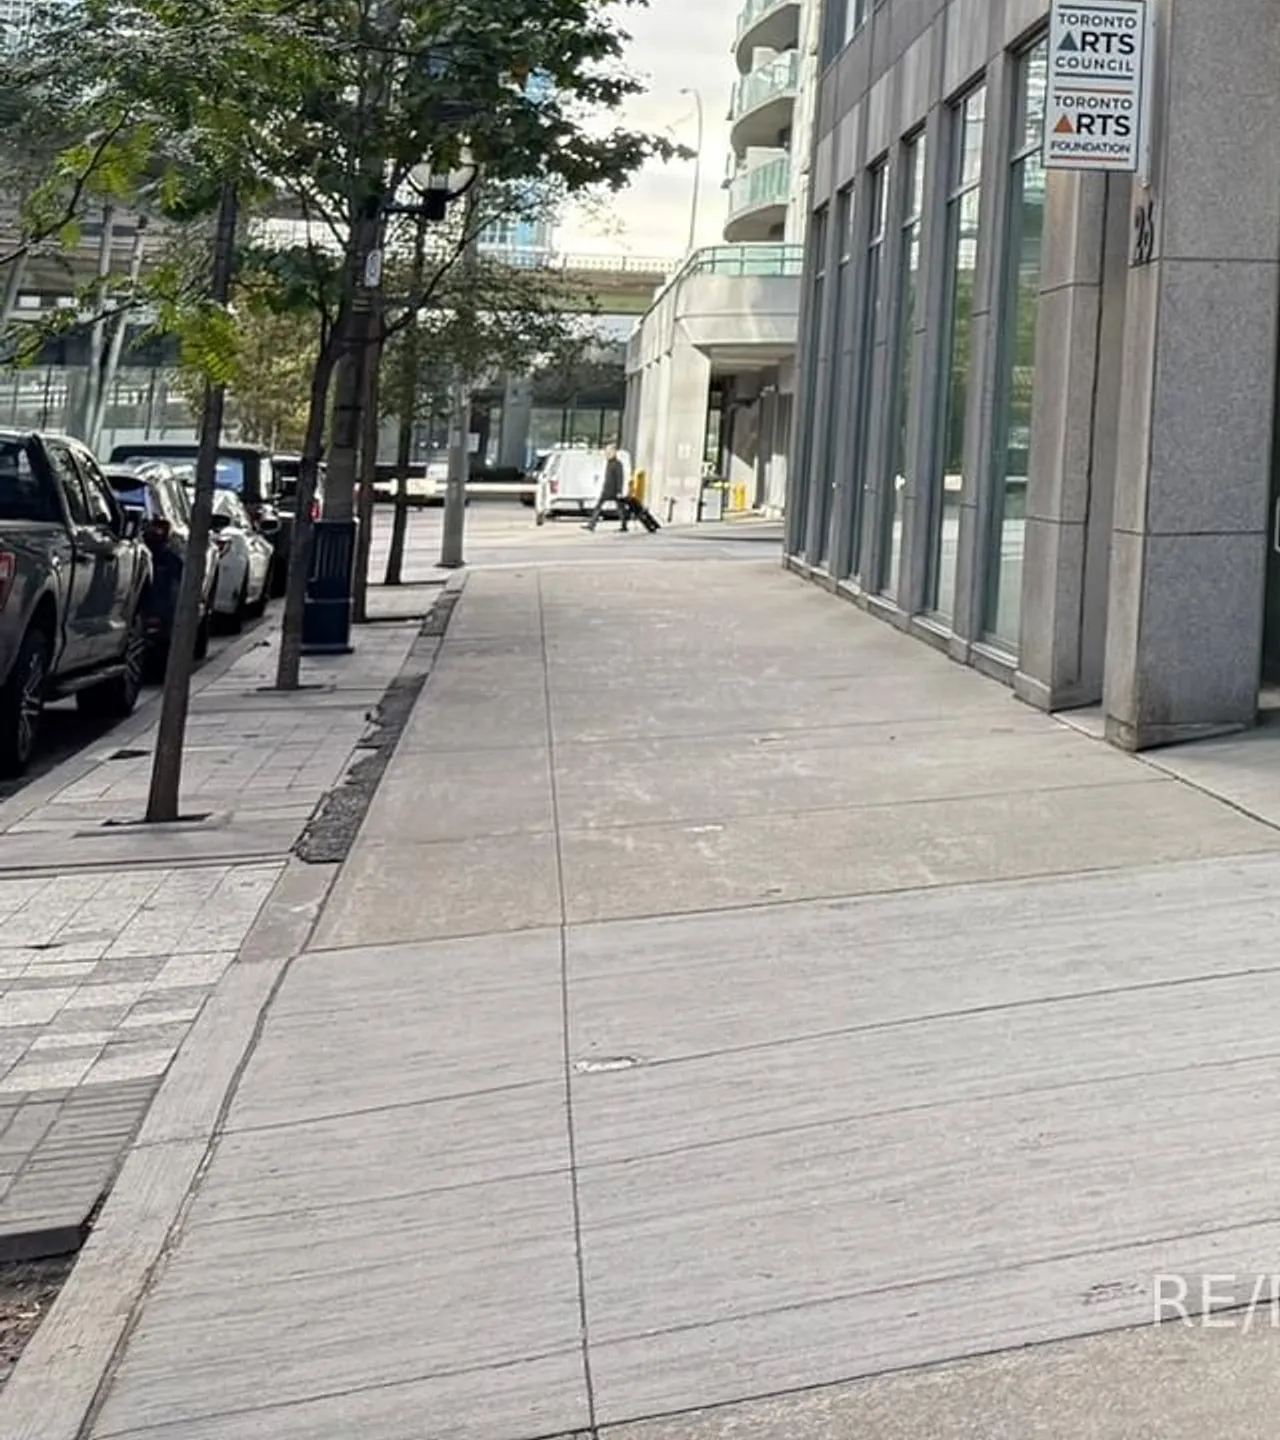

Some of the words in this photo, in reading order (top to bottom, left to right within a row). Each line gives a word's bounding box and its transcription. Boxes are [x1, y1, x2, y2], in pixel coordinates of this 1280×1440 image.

[1057, 13, 1137, 29] TORONTO
[1057, 30, 1136, 56] ARTS
[1055, 55, 1134, 73] COUNCIL
[1053, 95, 1134, 110] TORONTO
[1053, 113, 1132, 137] ARTS
[1050, 139, 1131, 154] FOUNDATION
